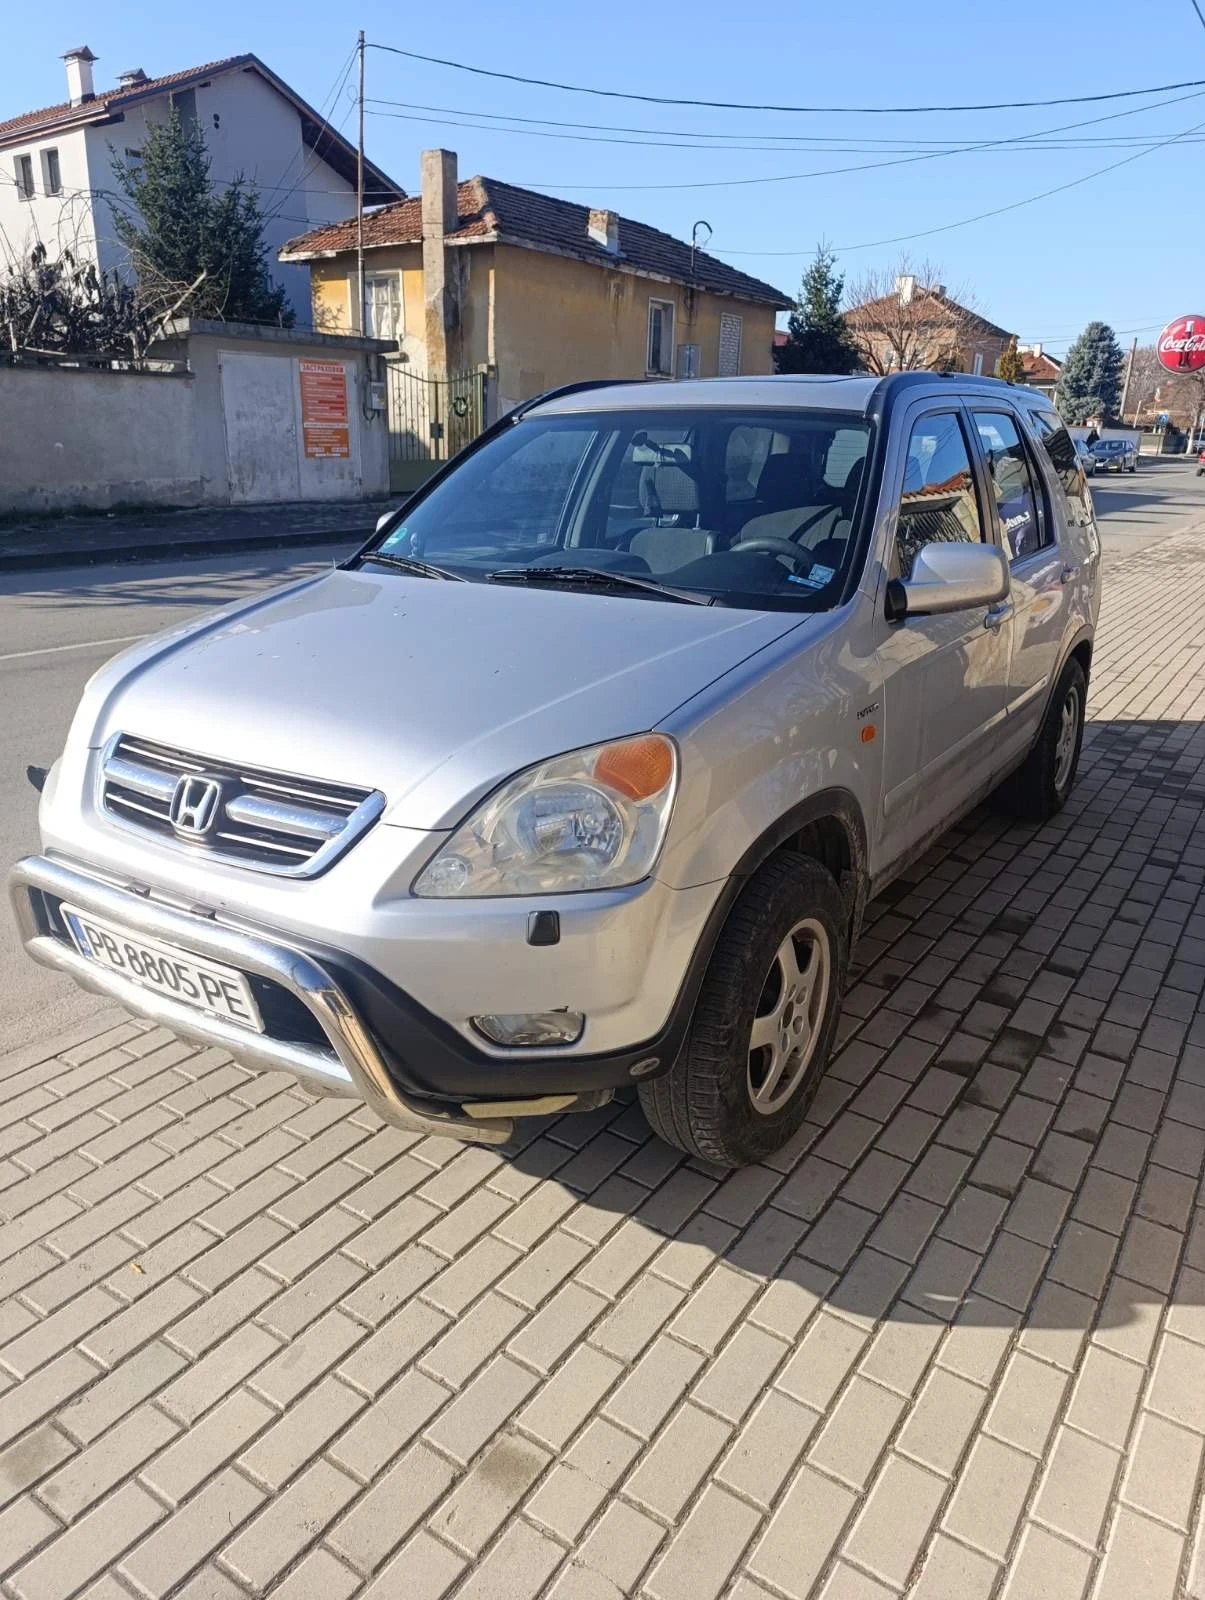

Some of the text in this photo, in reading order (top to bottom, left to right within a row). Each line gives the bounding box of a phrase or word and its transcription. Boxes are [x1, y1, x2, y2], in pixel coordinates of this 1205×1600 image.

[1160, 334, 1205, 352] Coca-Col
[83, 923, 250, 1020] PB 8805 PE
